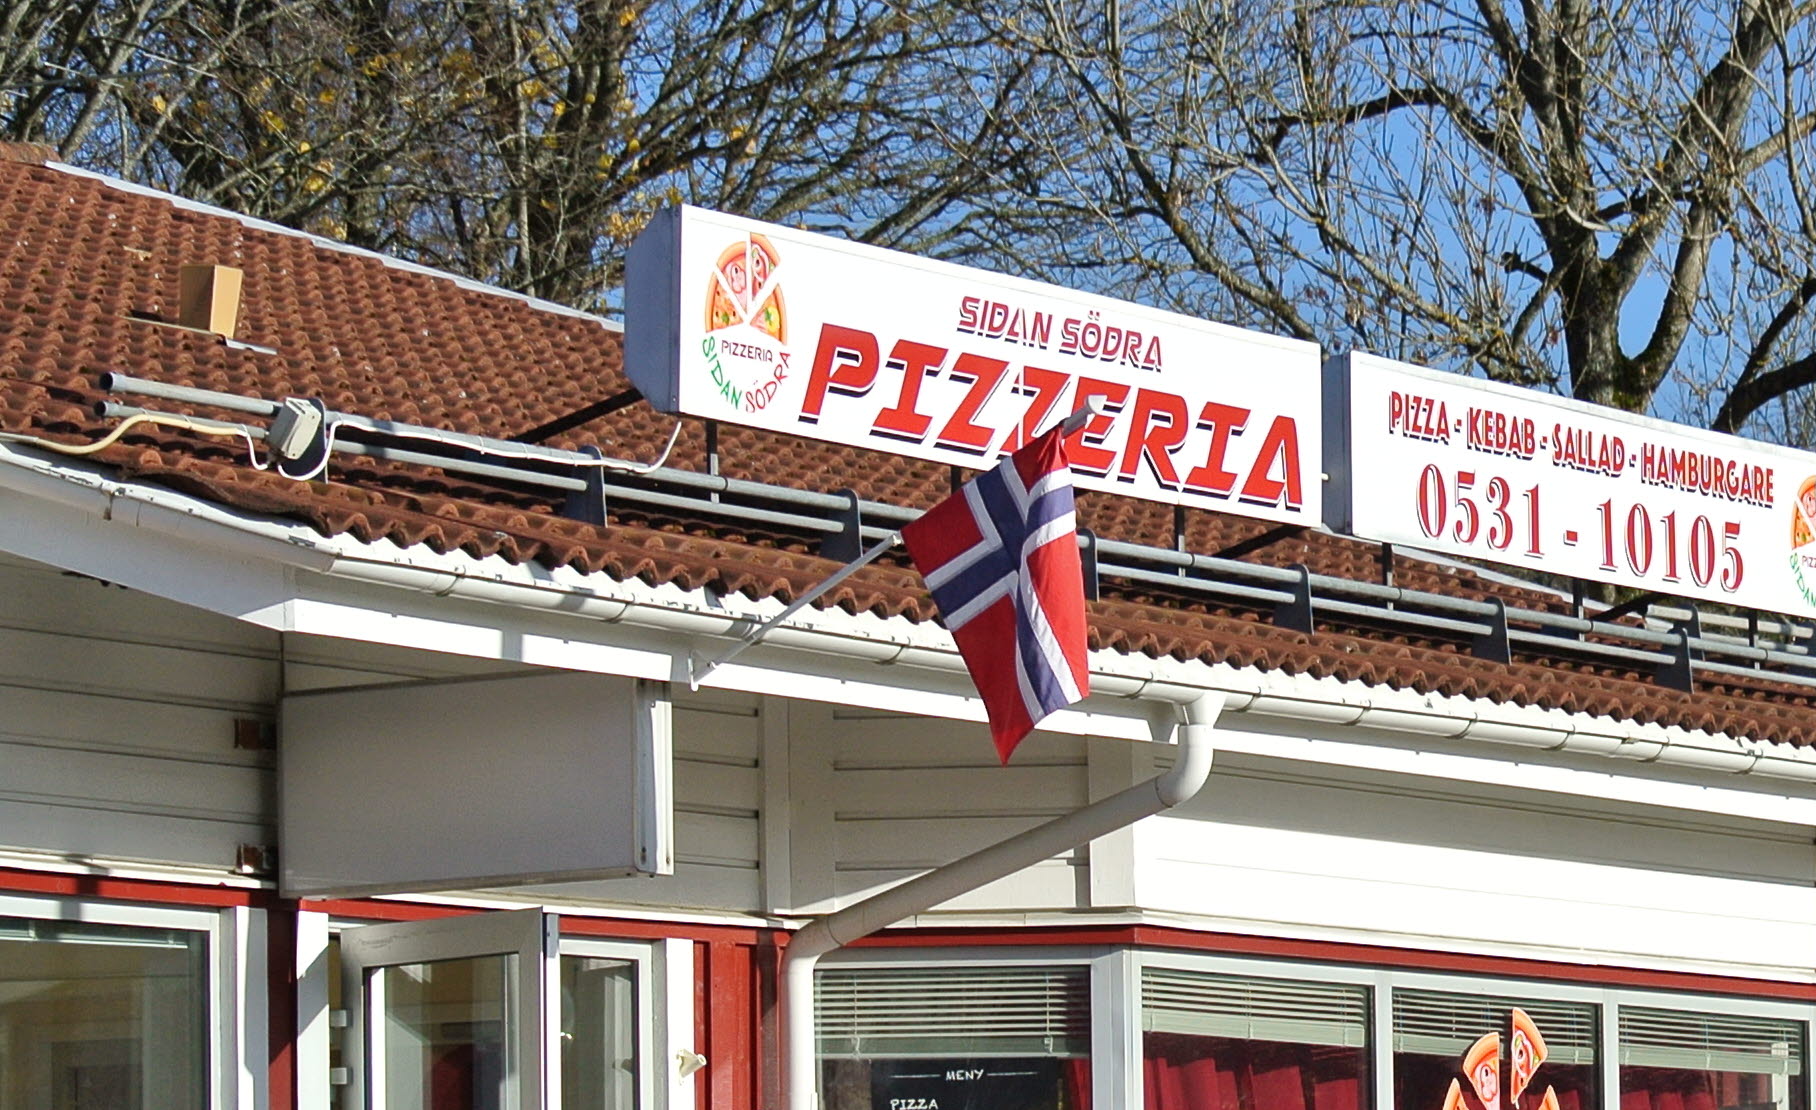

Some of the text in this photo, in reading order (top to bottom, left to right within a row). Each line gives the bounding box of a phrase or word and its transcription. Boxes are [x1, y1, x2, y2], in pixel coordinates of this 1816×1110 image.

[721, 340, 773, 363] PIZZERIA
[957, 296, 1162, 373] SIDAN SÖDRA
[702, 336, 791, 413] SIDAN SÖDRA
[799, 323, 1303, 513] PIZZERIA
[1389, 390, 1450, 443] PIZZA
[1467, 409, 1535, 460] KEBAB
[1552, 423, 1625, 477] SALLAD
[1641, 443, 1774, 509] HAMBURGARE
[1416, 463, 1545, 558] 0531
[1598, 498, 1744, 593] 10105
[890, 1099, 939, 1110] PIZZA
[945, 1069, 984, 1081] MENY
